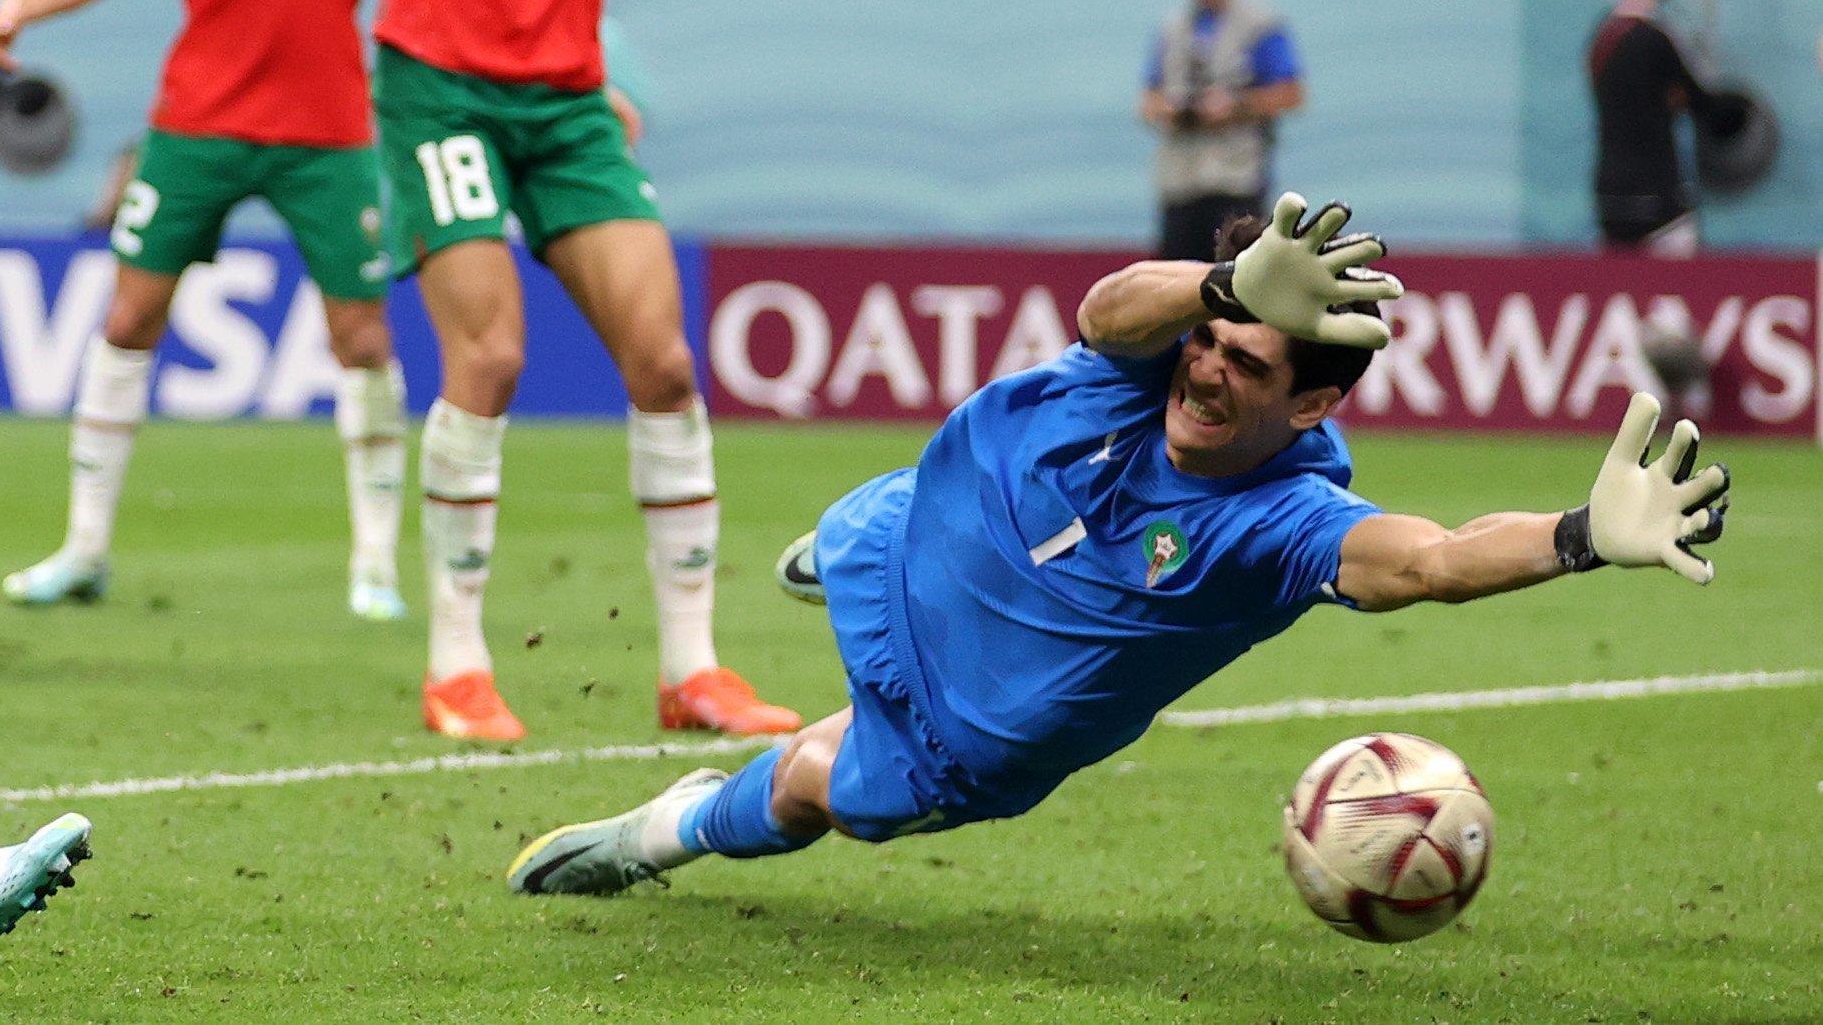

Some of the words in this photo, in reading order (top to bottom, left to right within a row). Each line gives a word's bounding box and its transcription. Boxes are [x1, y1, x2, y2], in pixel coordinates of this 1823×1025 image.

[109, 179, 160, 256] 2
[415, 134, 500, 227] 18
[709, 279, 1074, 418] QATA
[1355, 290, 1814, 424] RWAYS
